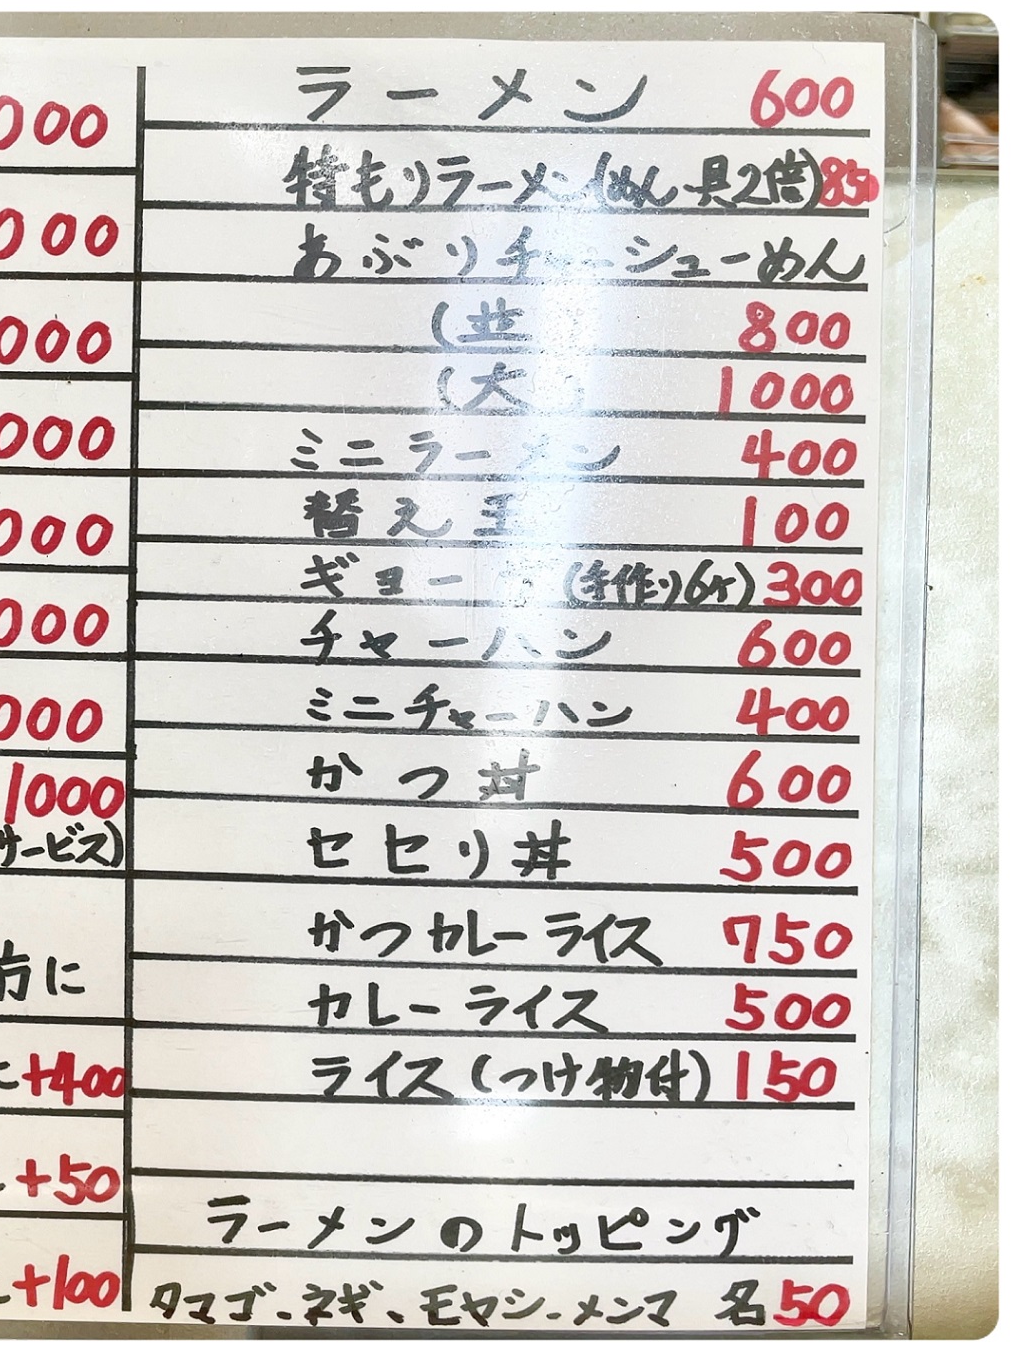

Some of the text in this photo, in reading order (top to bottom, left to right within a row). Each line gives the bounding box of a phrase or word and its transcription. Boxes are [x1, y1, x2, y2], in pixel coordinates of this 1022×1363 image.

[295, 66, 855, 128] ラーメン 600
[738, 301, 852, 355] 800
[719, 365, 855, 414] 1000
[741, 428, 858, 479] 400
[743, 496, 850, 546] 100
[763, 561, 863, 607] 300
[300, 609, 853, 669] チャーハン 600
[304, 683, 851, 736] ミニチャーハン 400
[4, 761, 126, 825] 1000
[306, 748, 853, 810] かつ丼 600
[306, 819, 854, 883] セセリ丼 500
[307, 909, 853, 966] かつカレーライス 750
[308, 983, 852, 1035] カレーライス 500
[21, 1051, 126, 1106] +400
[735, 1050, 838, 1103] 150
[16, 1153, 121, 1206] +50
[206, 1194, 762, 1258] ラーメンのトッピング
[12, 1254, 121, 1310] +100
[773, 1279, 851, 1327] 50
